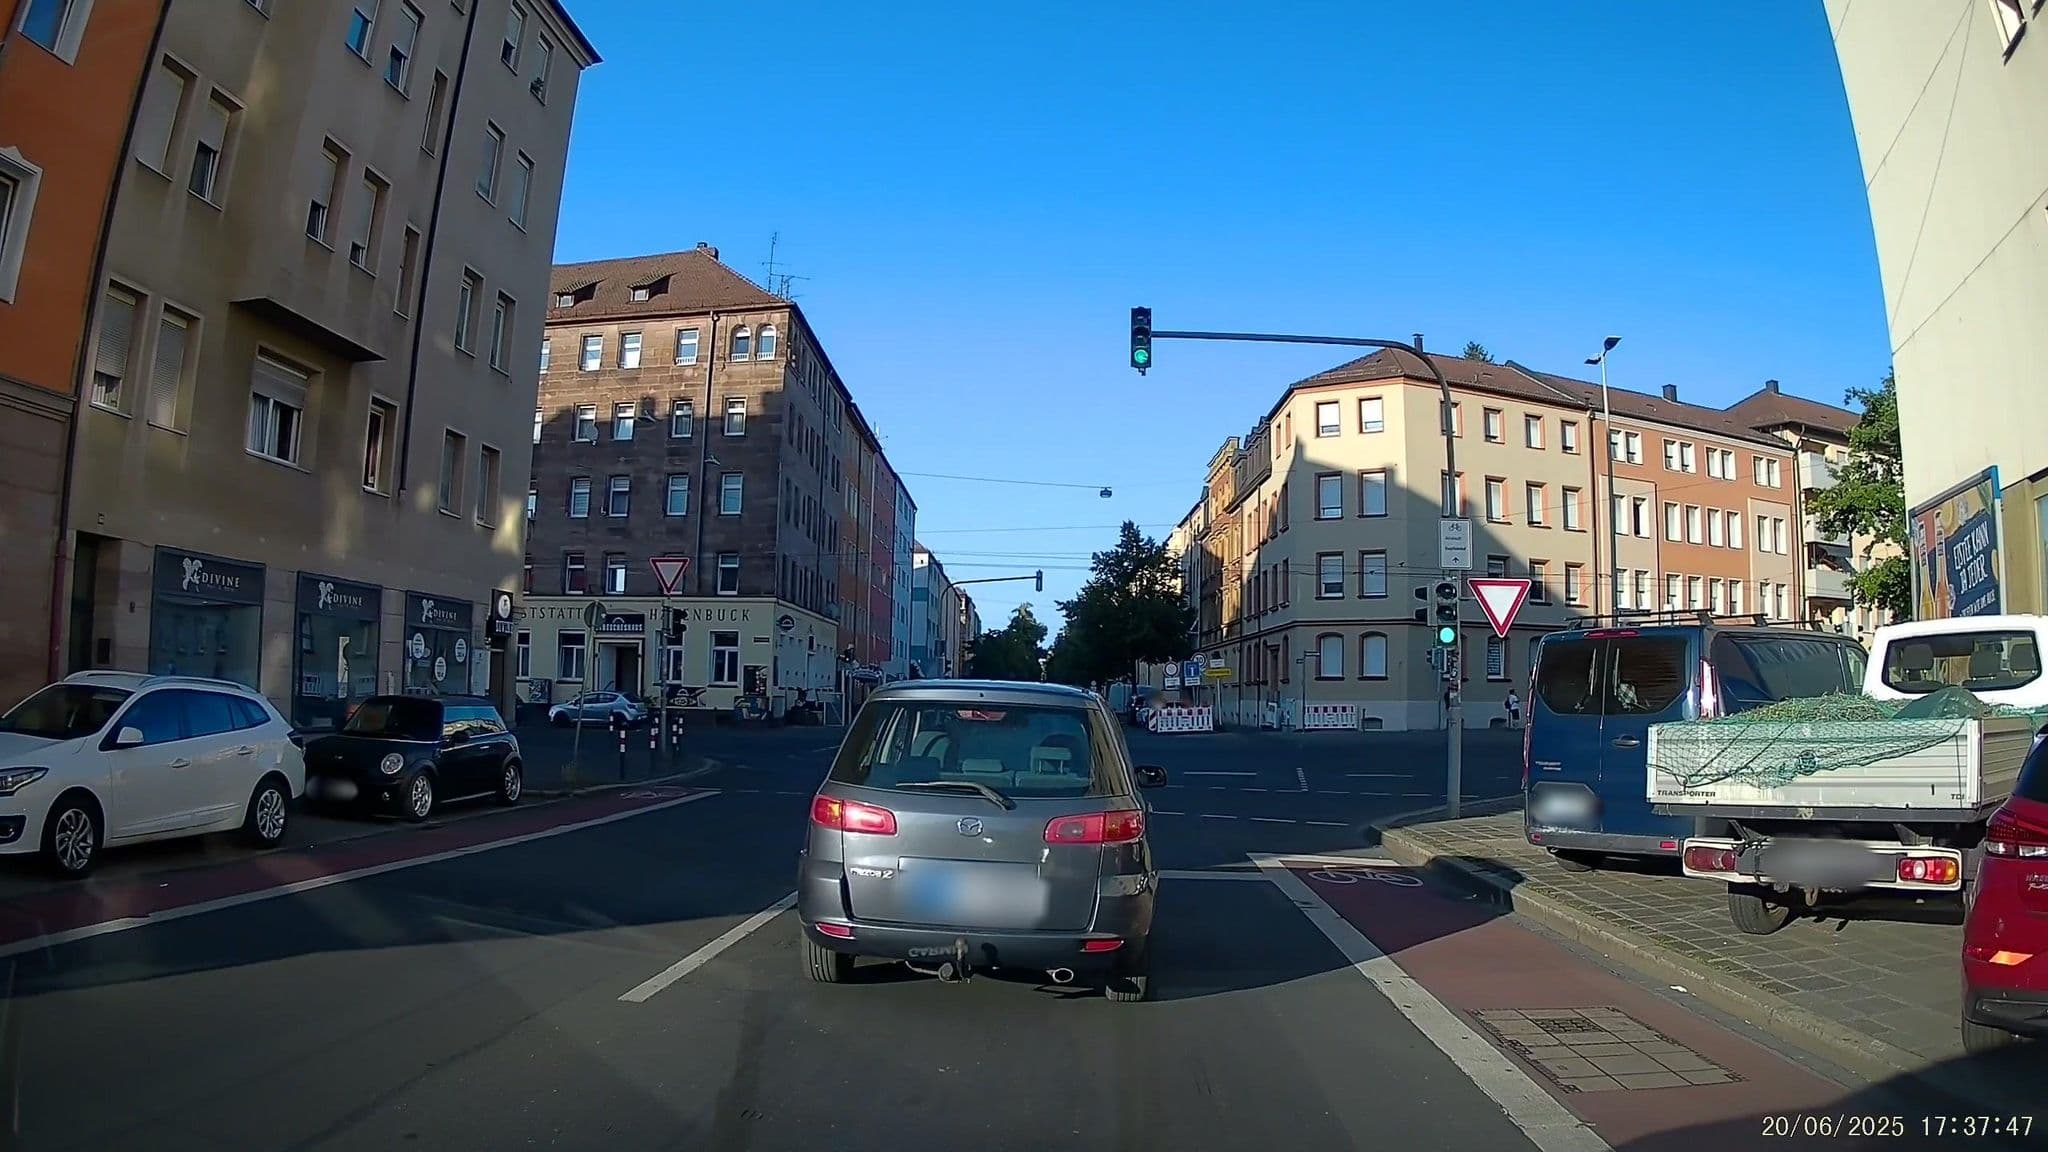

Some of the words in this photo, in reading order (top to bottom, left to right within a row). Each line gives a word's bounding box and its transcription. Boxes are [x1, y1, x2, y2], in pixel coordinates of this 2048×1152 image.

[1968, 554, 1988, 588] JEDER
[201, 572, 240, 588] DIVINE
[333, 593, 362, 606] DIVINE
[433, 609, 457, 621] DIVINE
[1657, 789, 1716, 798] TRANSPORTER
